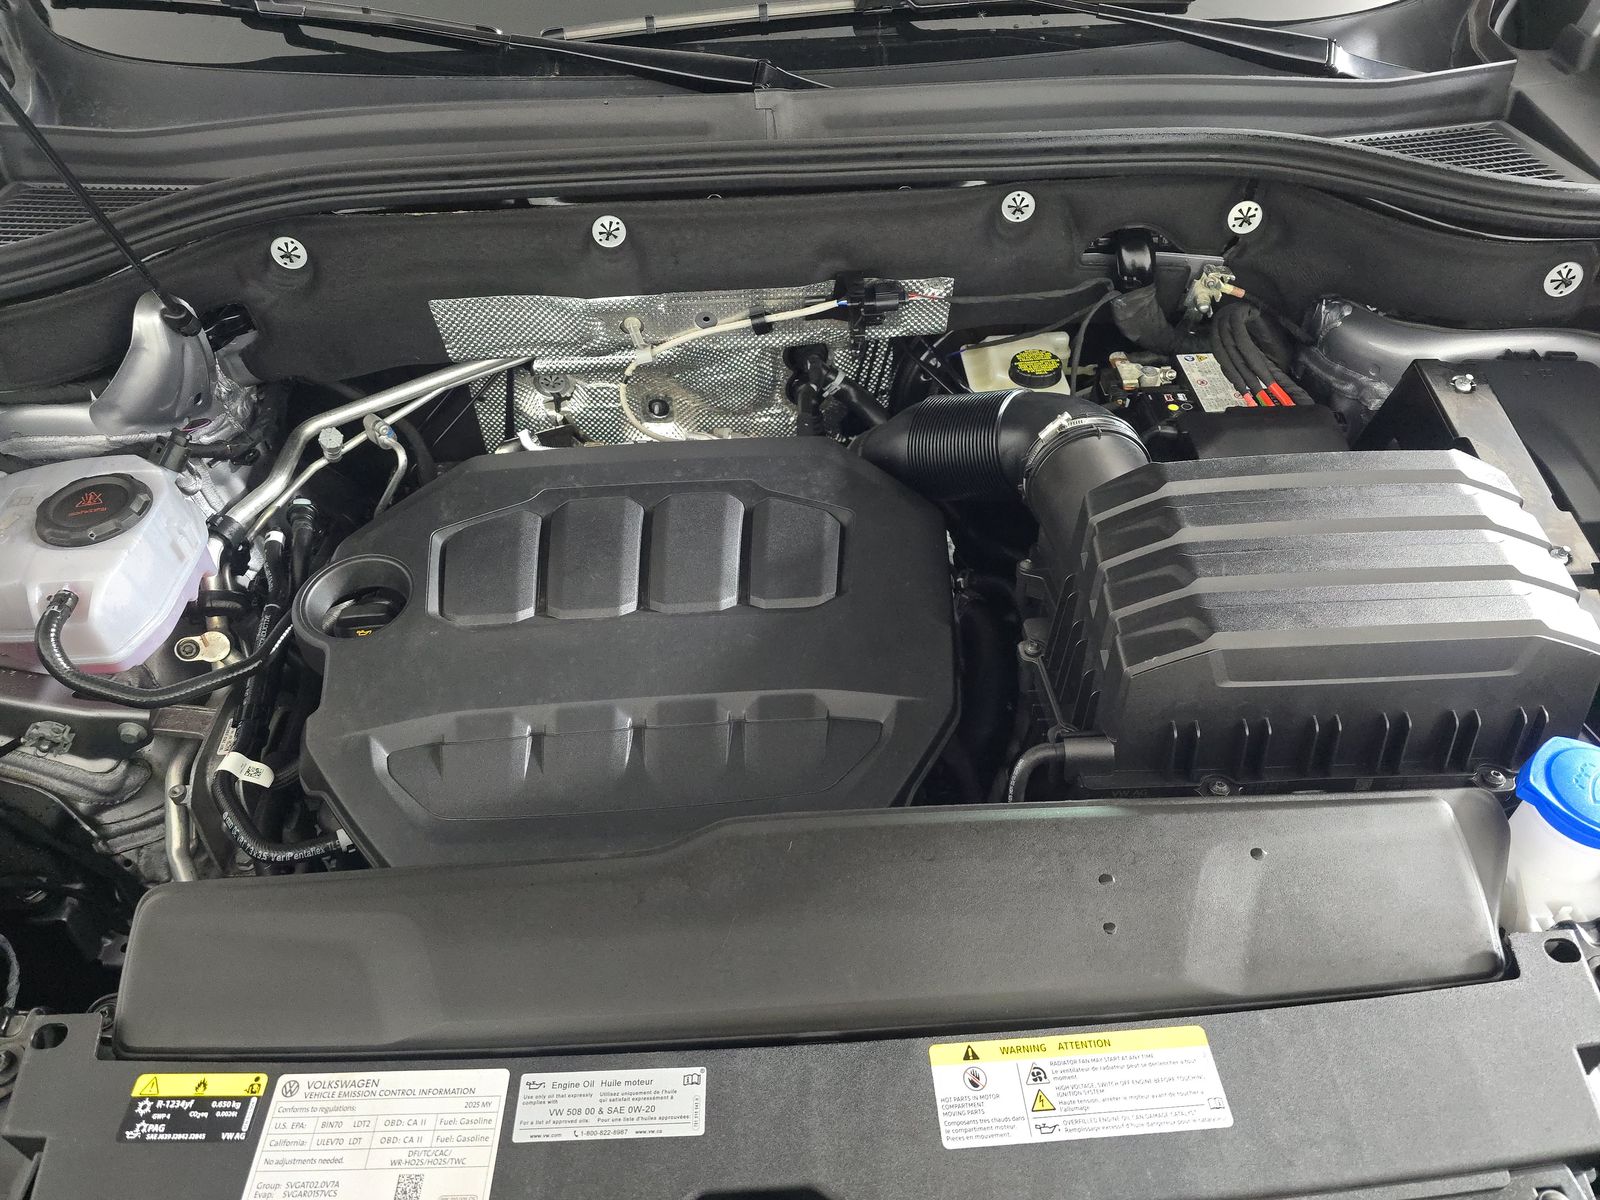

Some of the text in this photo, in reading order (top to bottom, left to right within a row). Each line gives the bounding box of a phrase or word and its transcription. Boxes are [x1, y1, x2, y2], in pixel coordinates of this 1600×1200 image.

[1000, 1039, 1111, 1055] WARNING ATTENTION
[307, 1079, 380, 1090] VOLKSWAGEN
[552, 1078, 653, 1091] Engine Oil Huile moteur
[304, 1087, 476, 1099] VEHICLE EMISSION CONTROL INFORMATION
[156, 1100, 195, 1110] R-1234yf
[232, 1101, 242, 1110] kg
[278, 1105, 309, 1113] Conforms
[319, 1104, 356, 1113] regulations:
[464, 1101, 492, 1109] 2025 MY
[549, 1108, 564, 1116] VW
[567, 1108, 582, 1116] 508
[607, 1106, 625, 1114] SAE
[628, 1105, 656, 1113] 0W-20
[148, 1124, 166, 1132] PAG
[275, 1122, 289, 1130] U.S.
[321, 1121, 343, 1129] BIN70
[353, 1120, 371, 1128] LDT2
[384, 1119, 405, 1127] OBD:
[439, 1117, 458, 1125] Fuel:
[459, 1116, 492, 1125] Gasoline
[221, 1132, 234, 1140] VW
[234, 1132, 246, 1140] AG
[269, 1138, 307, 1148] California:
[316, 1137, 344, 1146] ULEV70
[348, 1137, 362, 1145] LDT
[380, 1136, 401, 1144] OBD:
[403, 1136, 416, 1144] CA
[436, 1135, 454, 1143] Fuel:
[456, 1134, 489, 1143] Gasoline
[274, 1156, 317, 1166] adjustments
[319, 1156, 344, 1165] needed.
[256, 1182, 282, 1190] Group:
